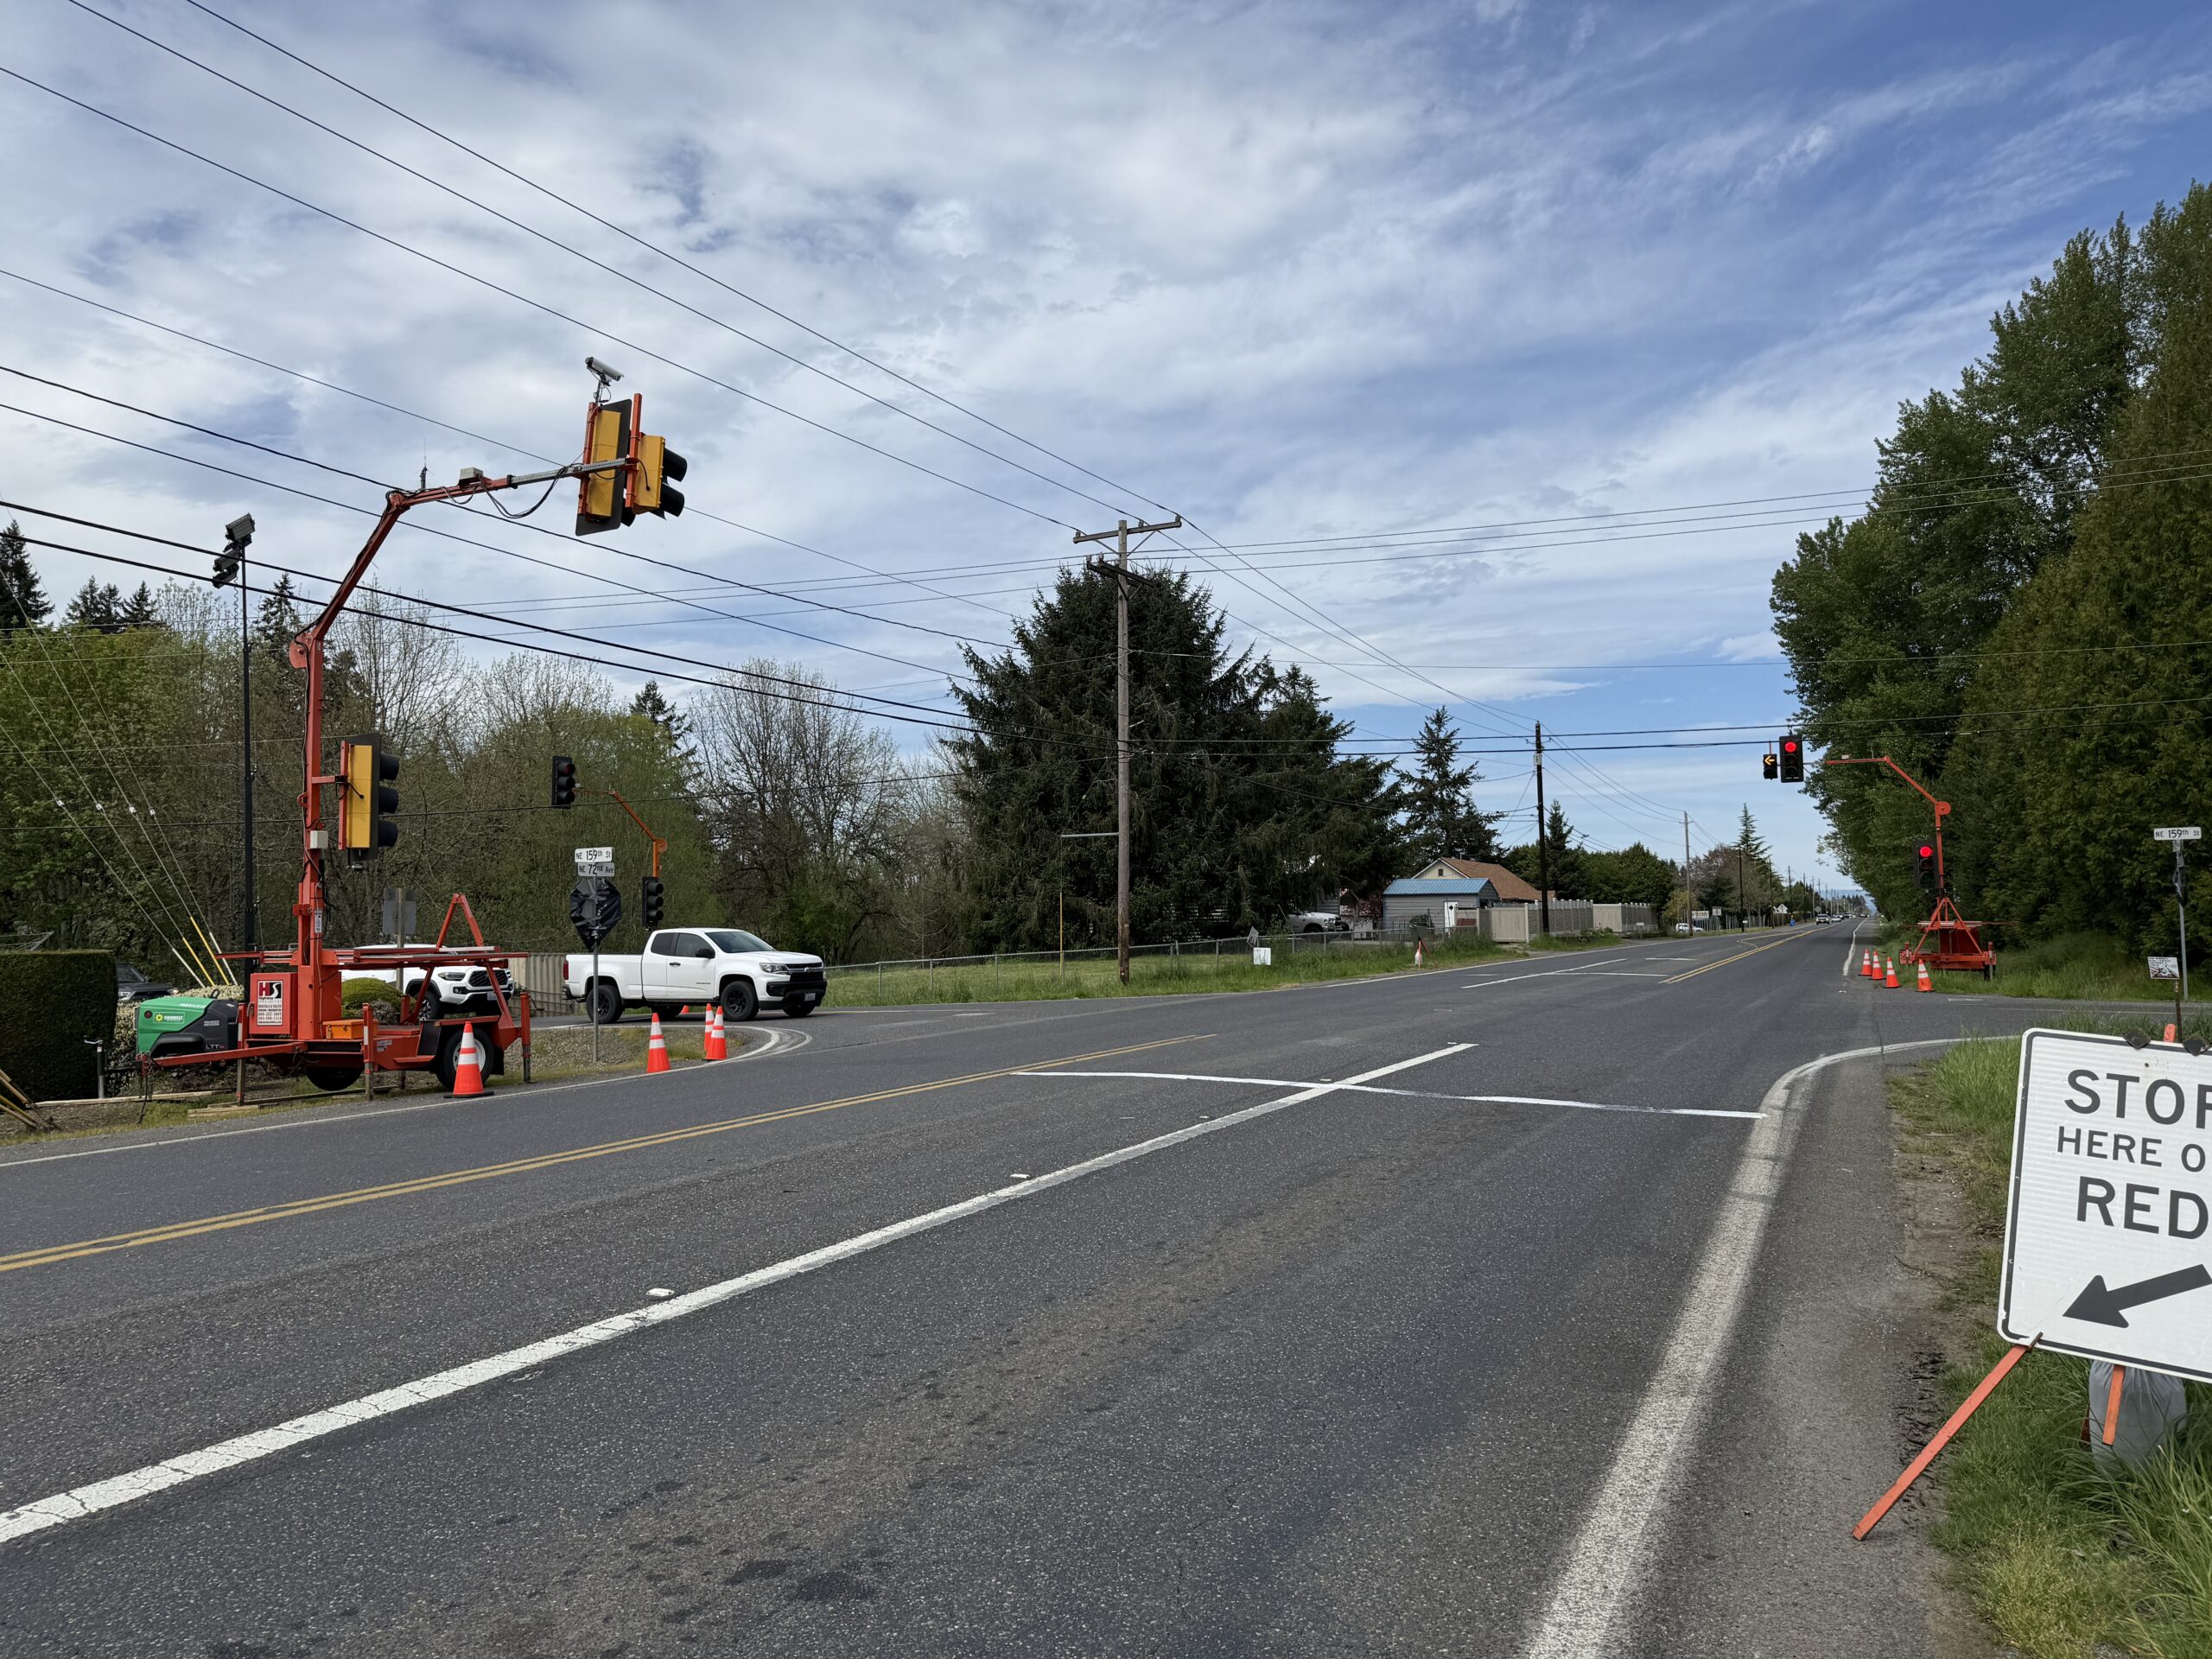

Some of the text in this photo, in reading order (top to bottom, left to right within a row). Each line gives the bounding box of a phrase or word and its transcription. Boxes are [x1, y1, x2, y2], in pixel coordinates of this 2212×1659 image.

[2168, 829, 2189, 839] 159th
[586, 849, 603, 861] 159th
[588, 863, 603, 875] 72nd
[2056, 1125, 2163, 1167] HERE
[2076, 1175, 2209, 1240] RED
